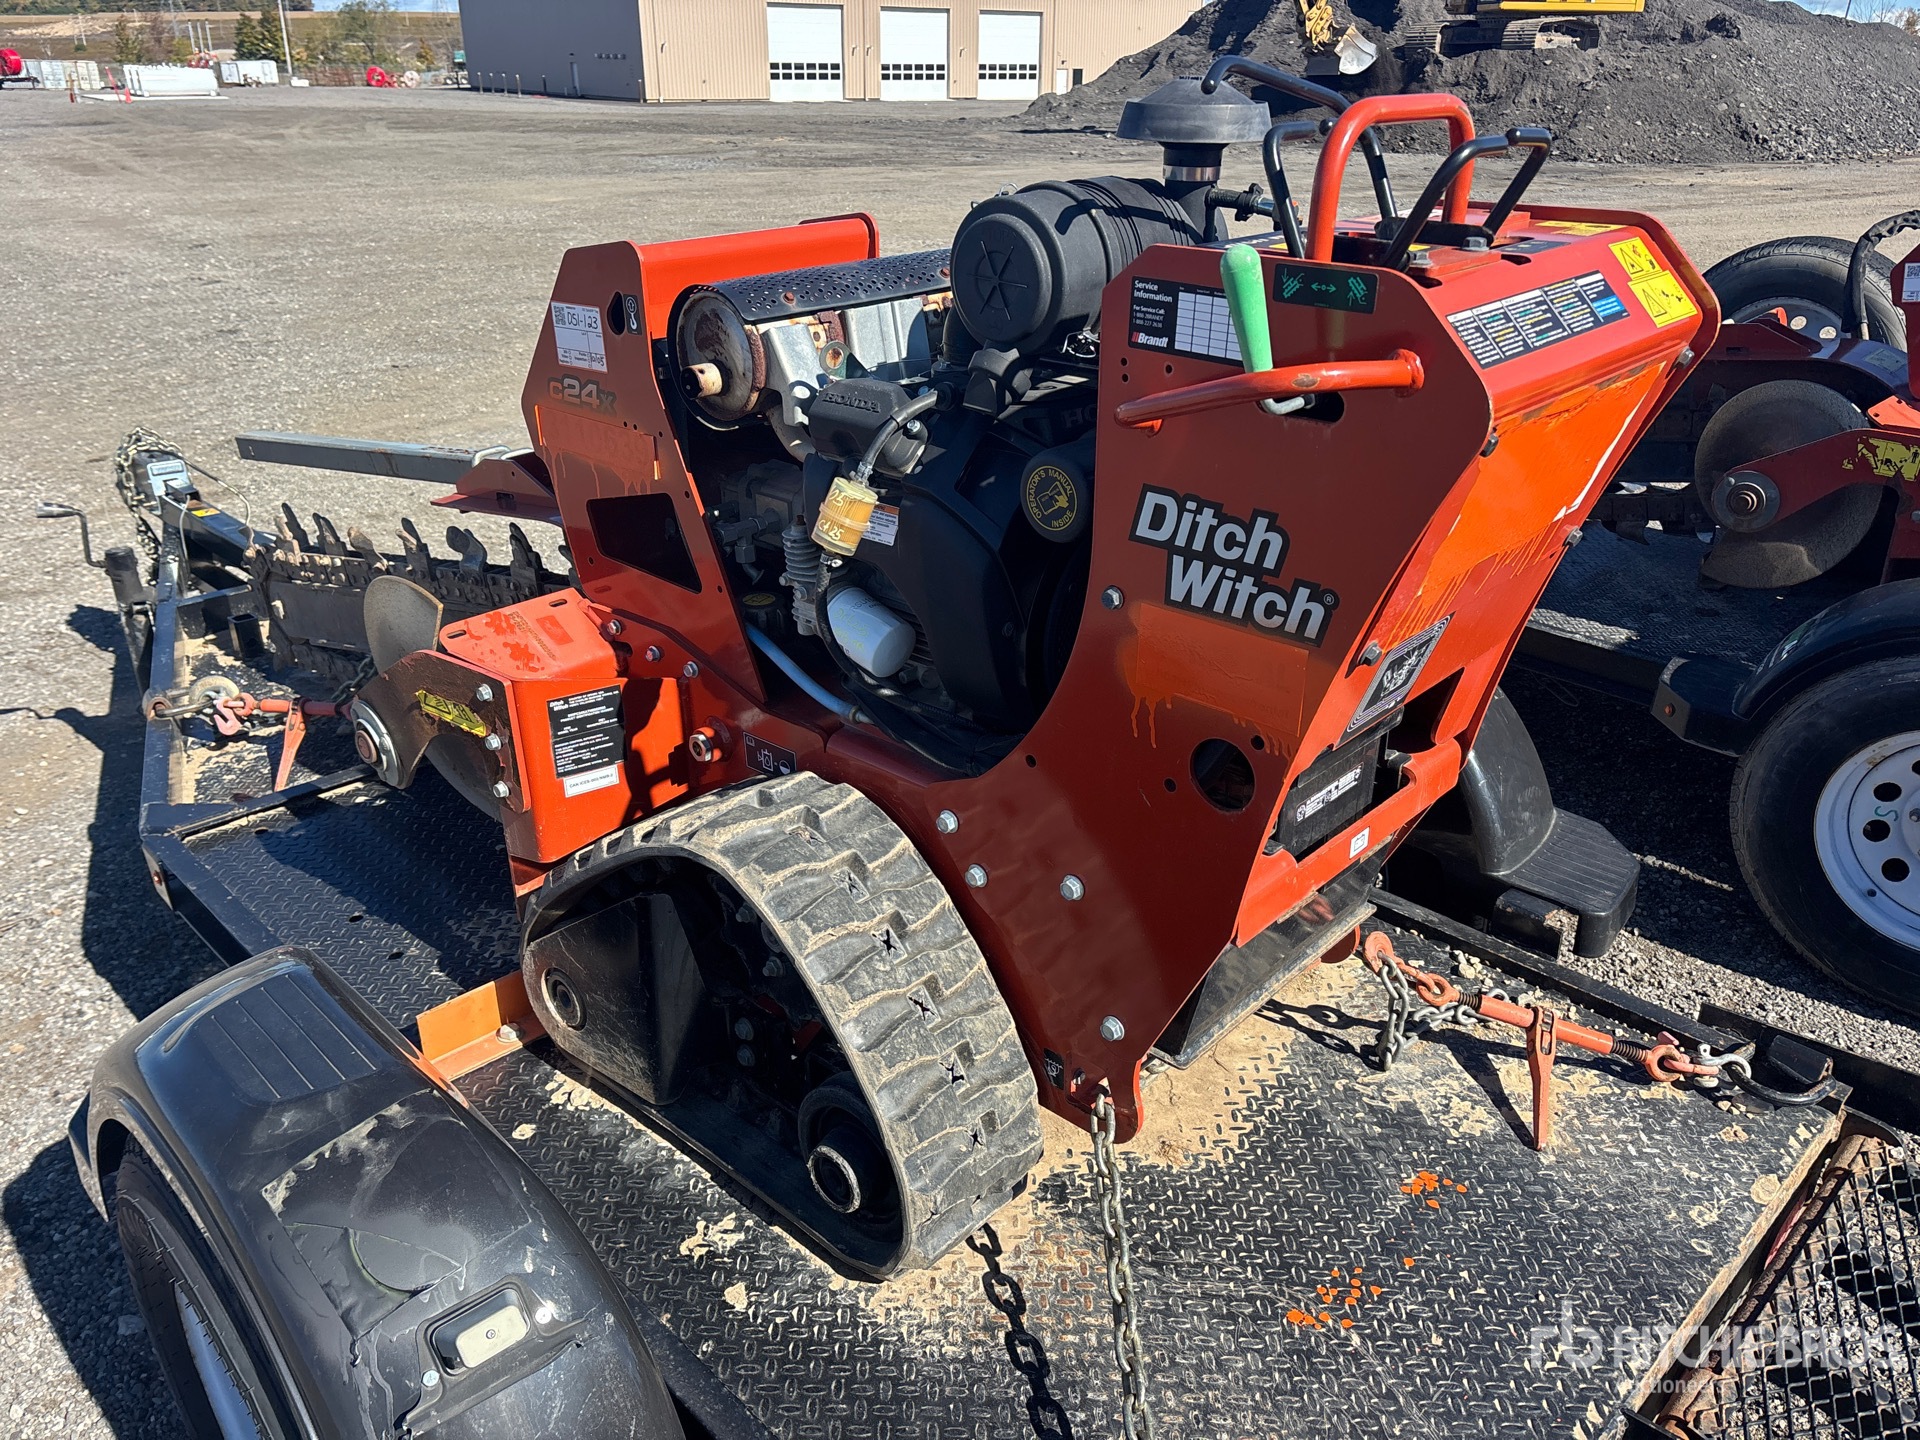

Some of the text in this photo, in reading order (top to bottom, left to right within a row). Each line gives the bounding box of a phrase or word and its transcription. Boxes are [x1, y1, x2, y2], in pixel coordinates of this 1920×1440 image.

[1134, 280, 1158, 291] Service
[1133, 290, 1172, 303] Information
[1138, 332, 1169, 348] Brandt
[1028, 468, 1074, 519] OPERATOR'S MANUAL
[1051, 509, 1073, 528] INSIDE
[1135, 491, 1284, 570] Ditch
